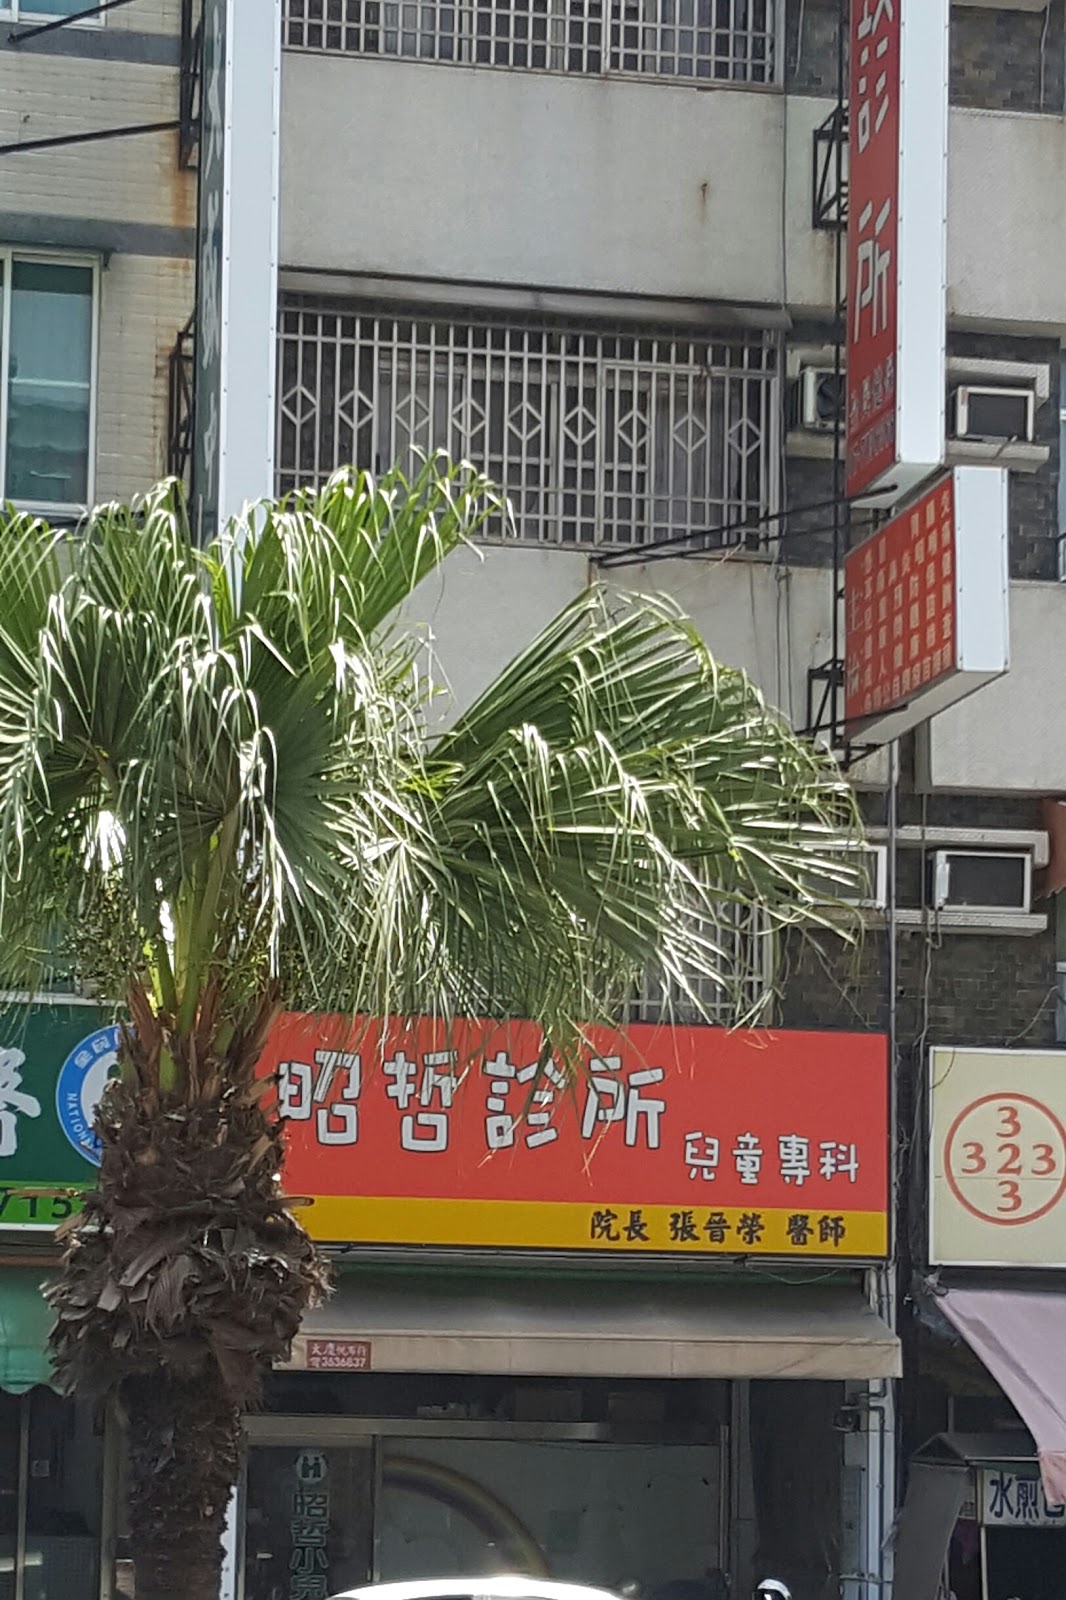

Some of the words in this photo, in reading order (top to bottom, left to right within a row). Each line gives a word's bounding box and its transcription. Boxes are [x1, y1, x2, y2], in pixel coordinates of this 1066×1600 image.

[279, 1050, 666, 1152] 昭哲診所
[685, 1130, 859, 1185] 兒童專科
[590, 1209, 650, 1242] 院長
[786, 1214, 846, 1247] 醫師
